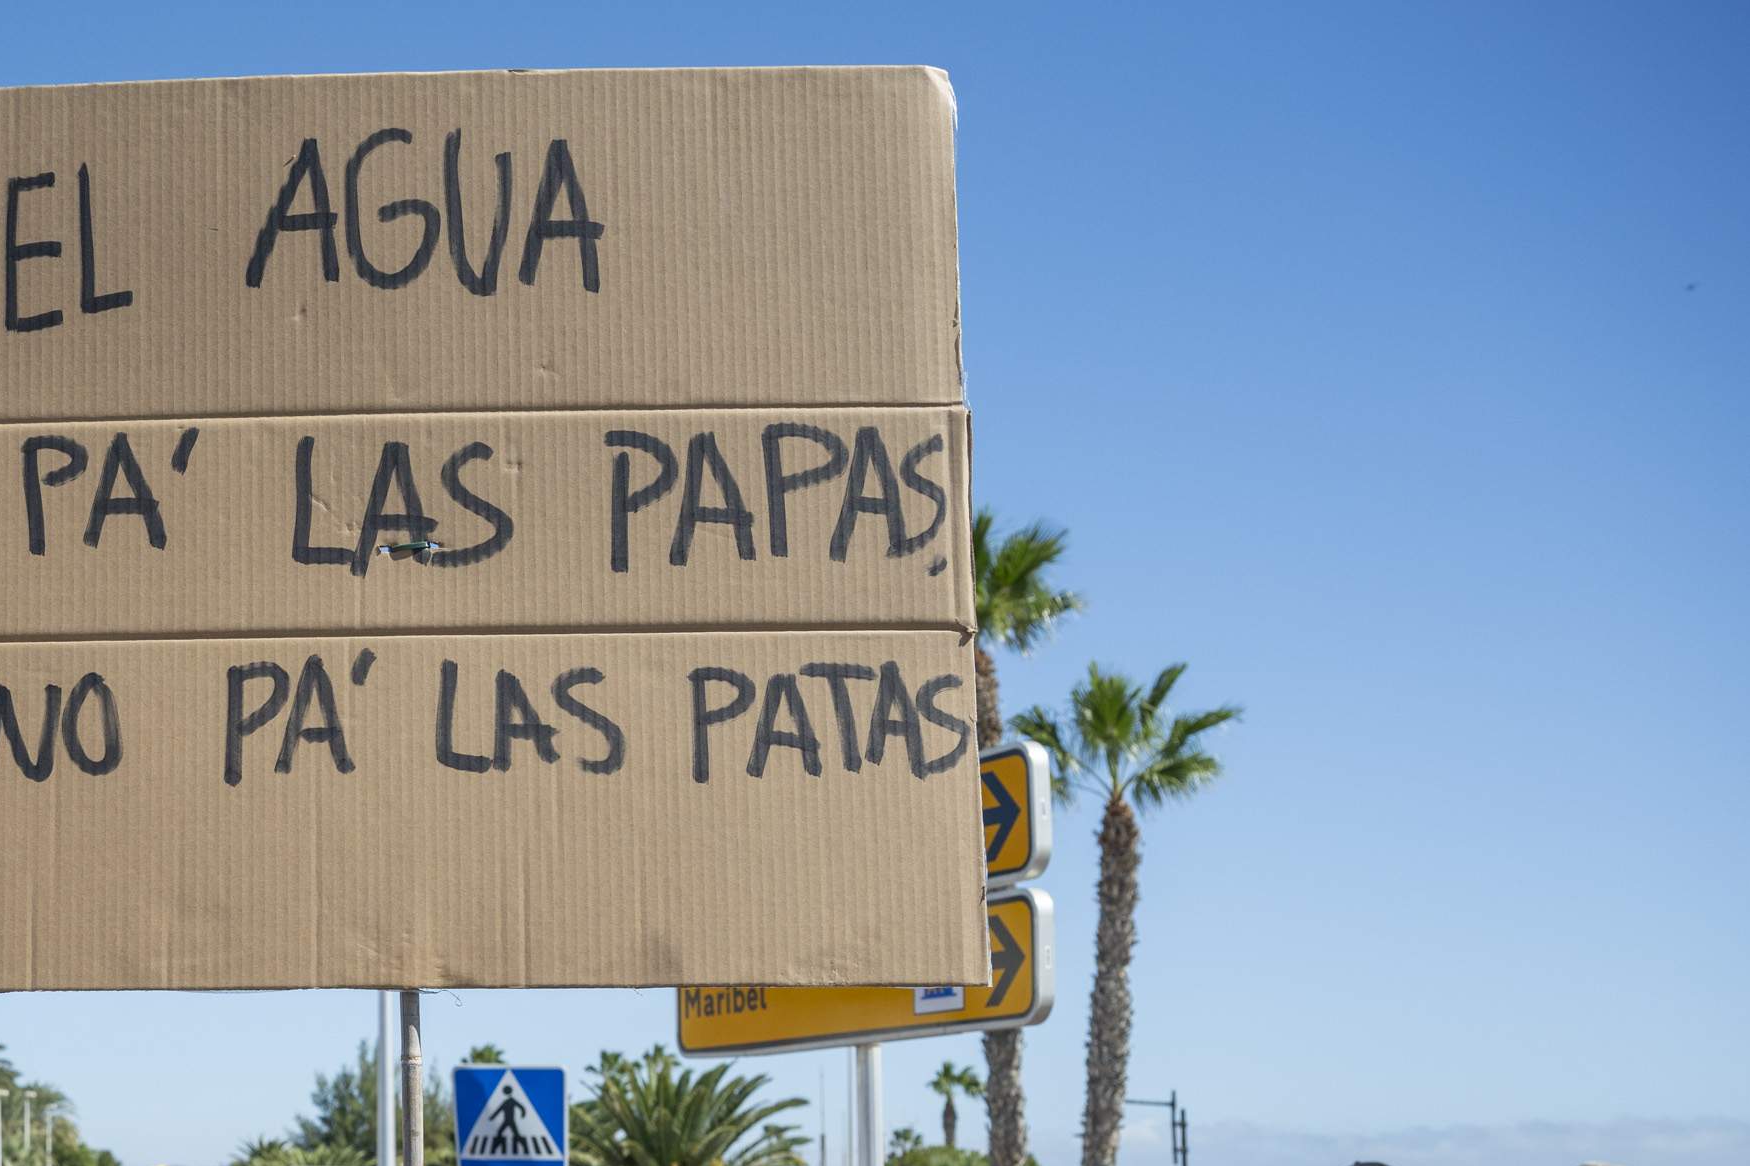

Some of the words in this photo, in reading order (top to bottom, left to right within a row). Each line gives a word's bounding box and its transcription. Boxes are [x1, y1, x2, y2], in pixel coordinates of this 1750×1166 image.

[6, 161, 133, 332] EL
[246, 128, 604, 297] AGUA
[292, 436, 515, 576] LAS
[436, 660, 627, 774] LAS
[688, 660, 971, 783] PATAS
[684, 988, 767, 1019] Maribel
